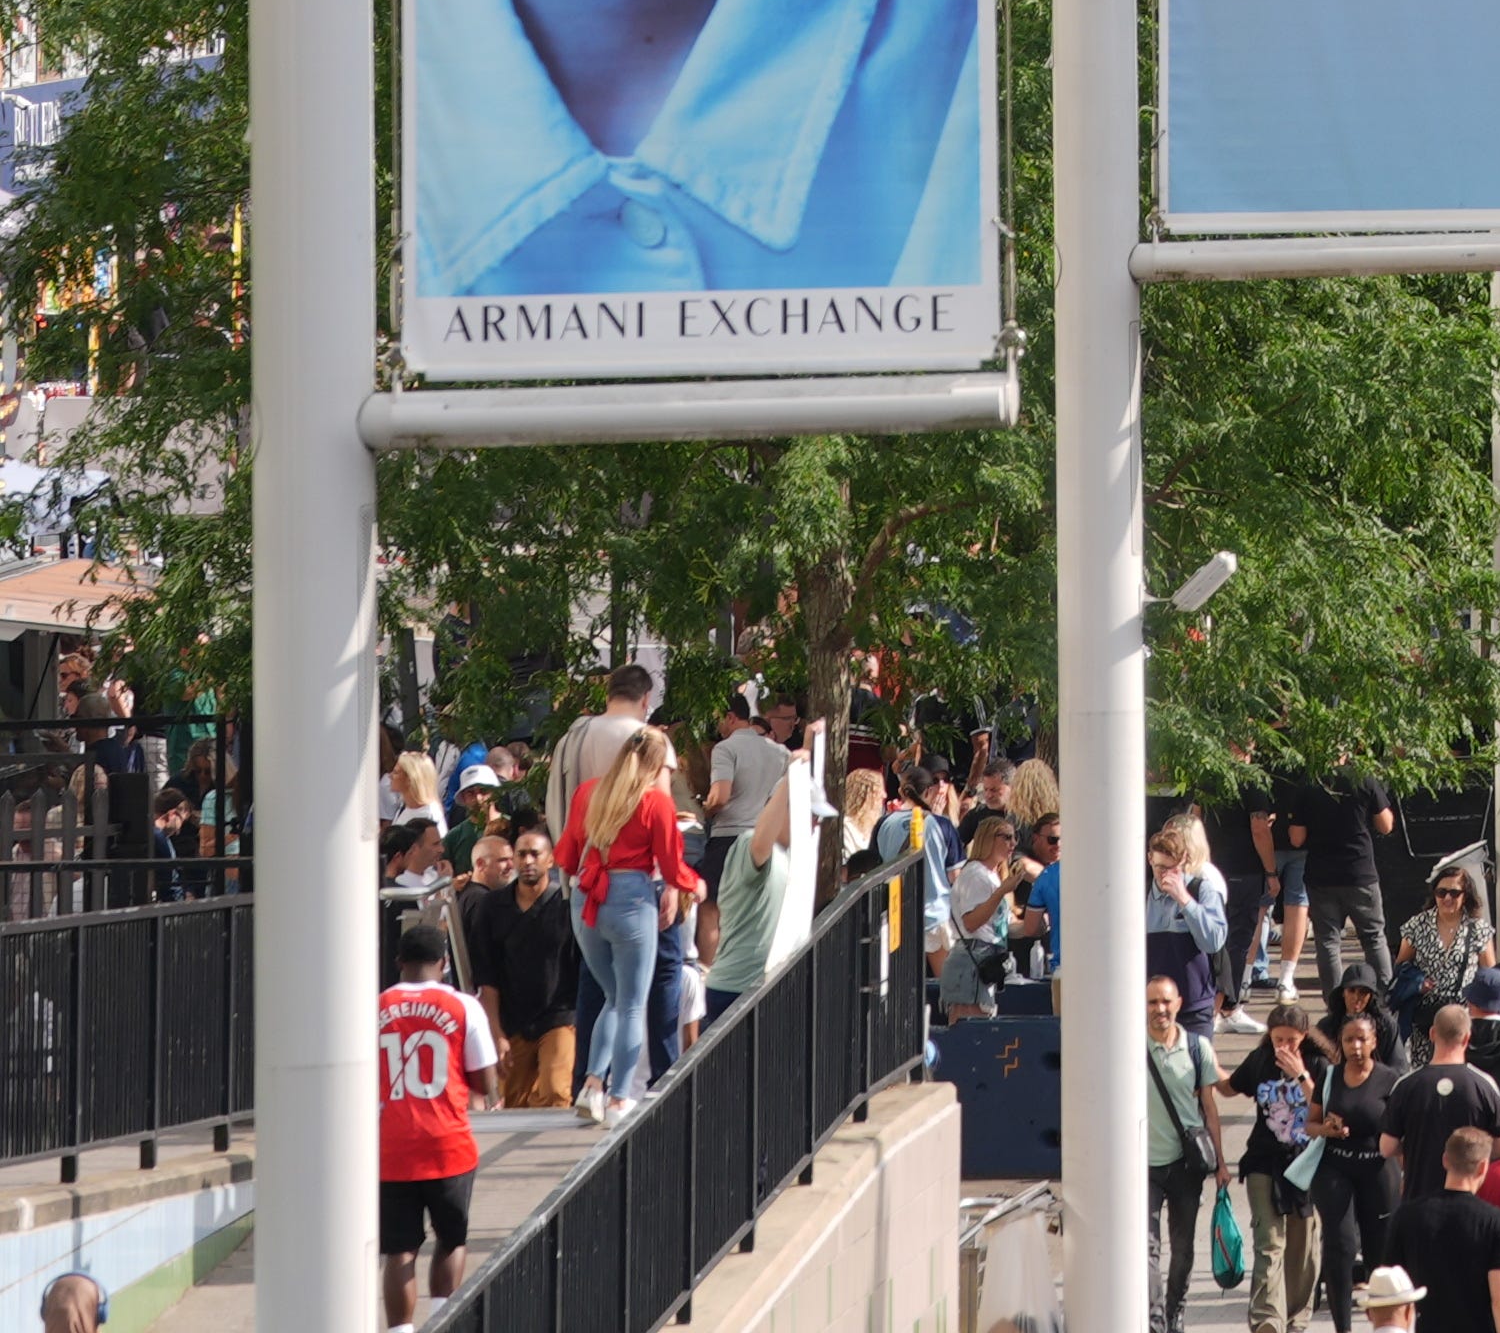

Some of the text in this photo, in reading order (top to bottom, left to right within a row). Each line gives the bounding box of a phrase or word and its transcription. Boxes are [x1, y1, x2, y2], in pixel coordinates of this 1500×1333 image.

[443, 291, 956, 344] ARMANI EXCHANGE
[380, 1030, 450, 1100] 10
